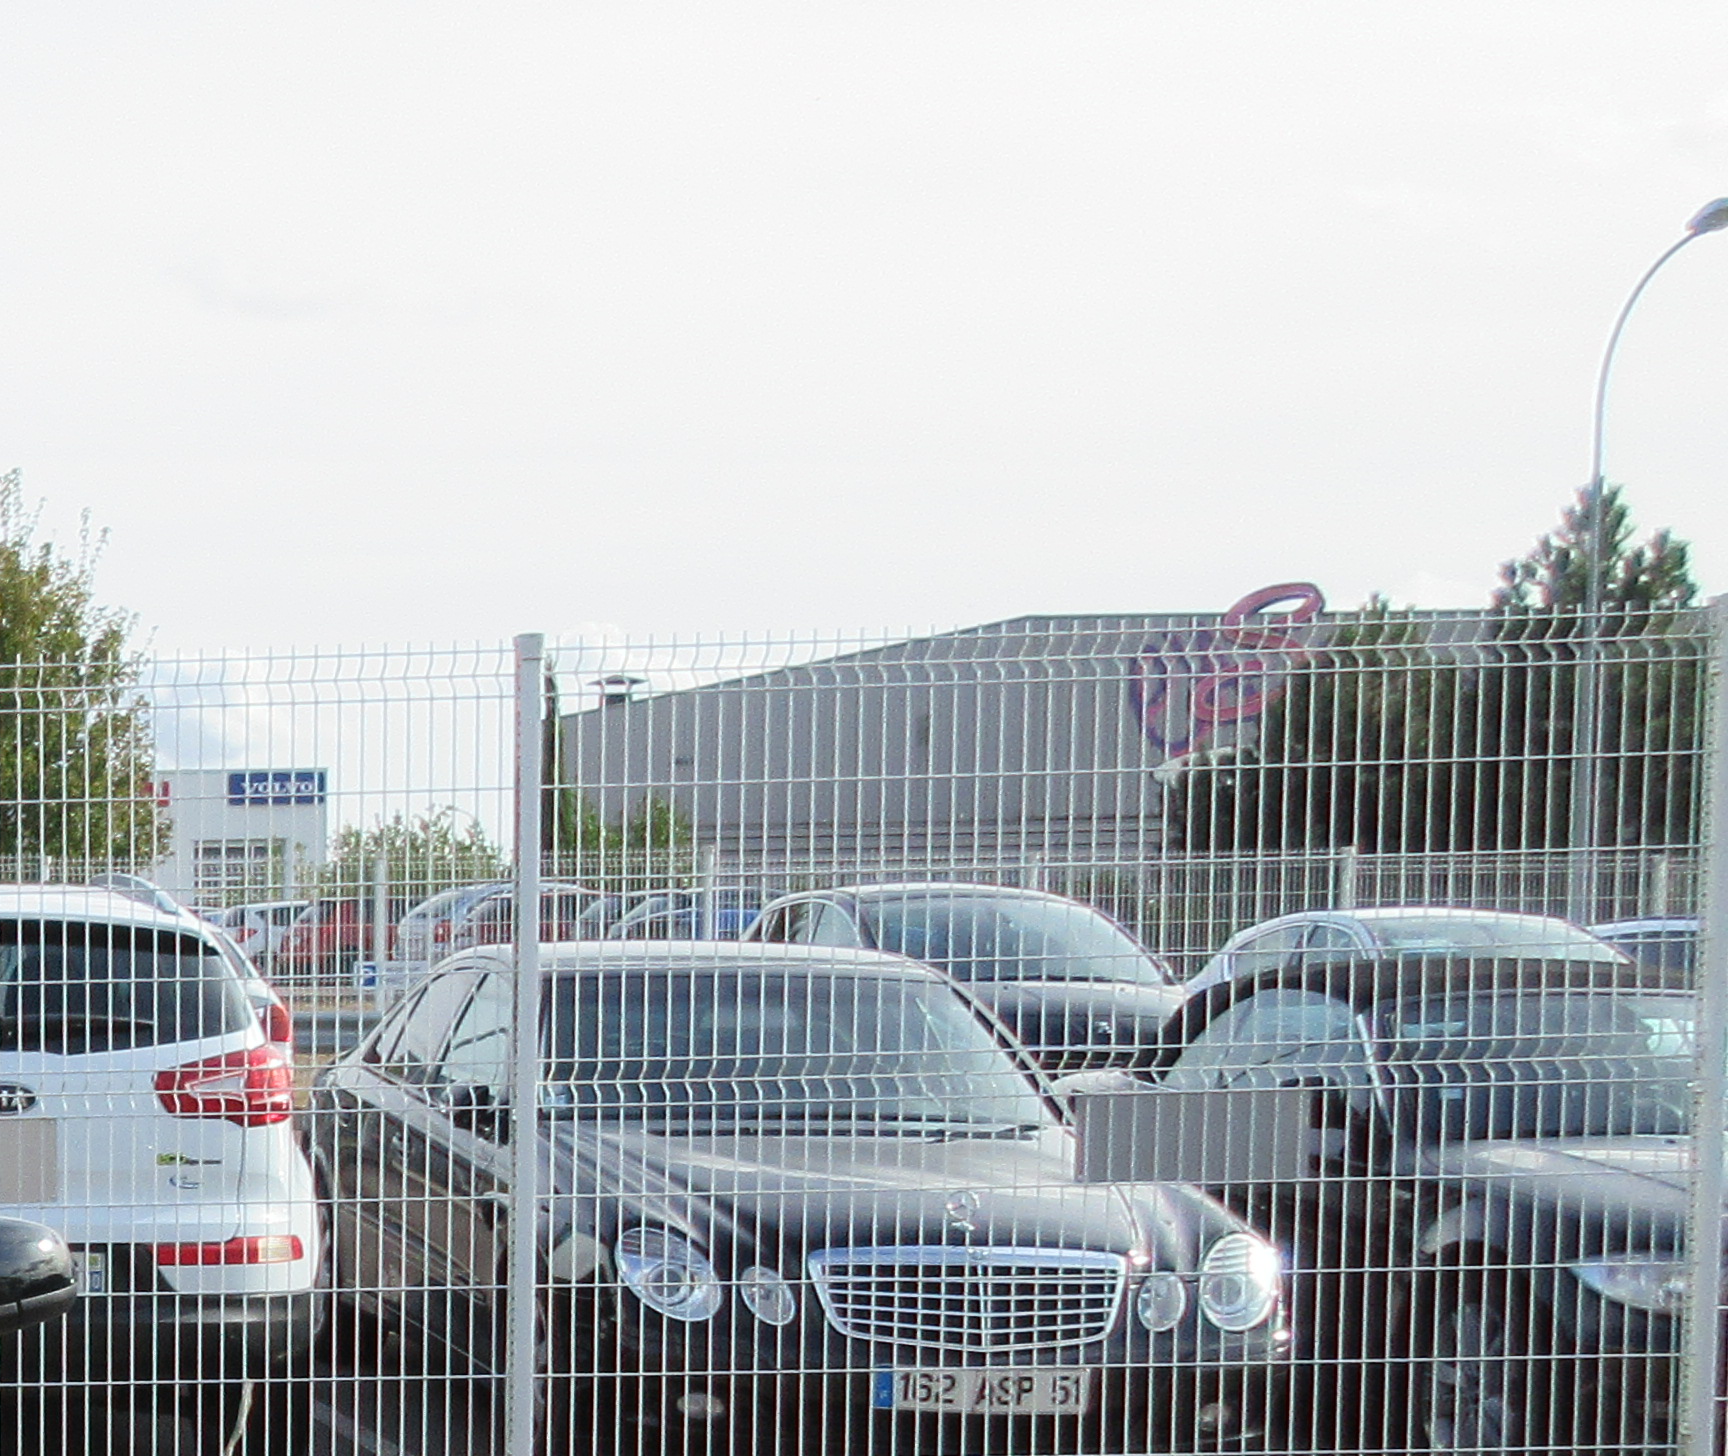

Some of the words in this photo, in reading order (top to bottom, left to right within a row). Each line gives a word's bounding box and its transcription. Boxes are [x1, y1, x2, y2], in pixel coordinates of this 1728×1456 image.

[241, 781, 314, 794] VOLVO
[975, 1376, 1034, 1406] ASP
[1051, 1376, 1081, 1405] 51
